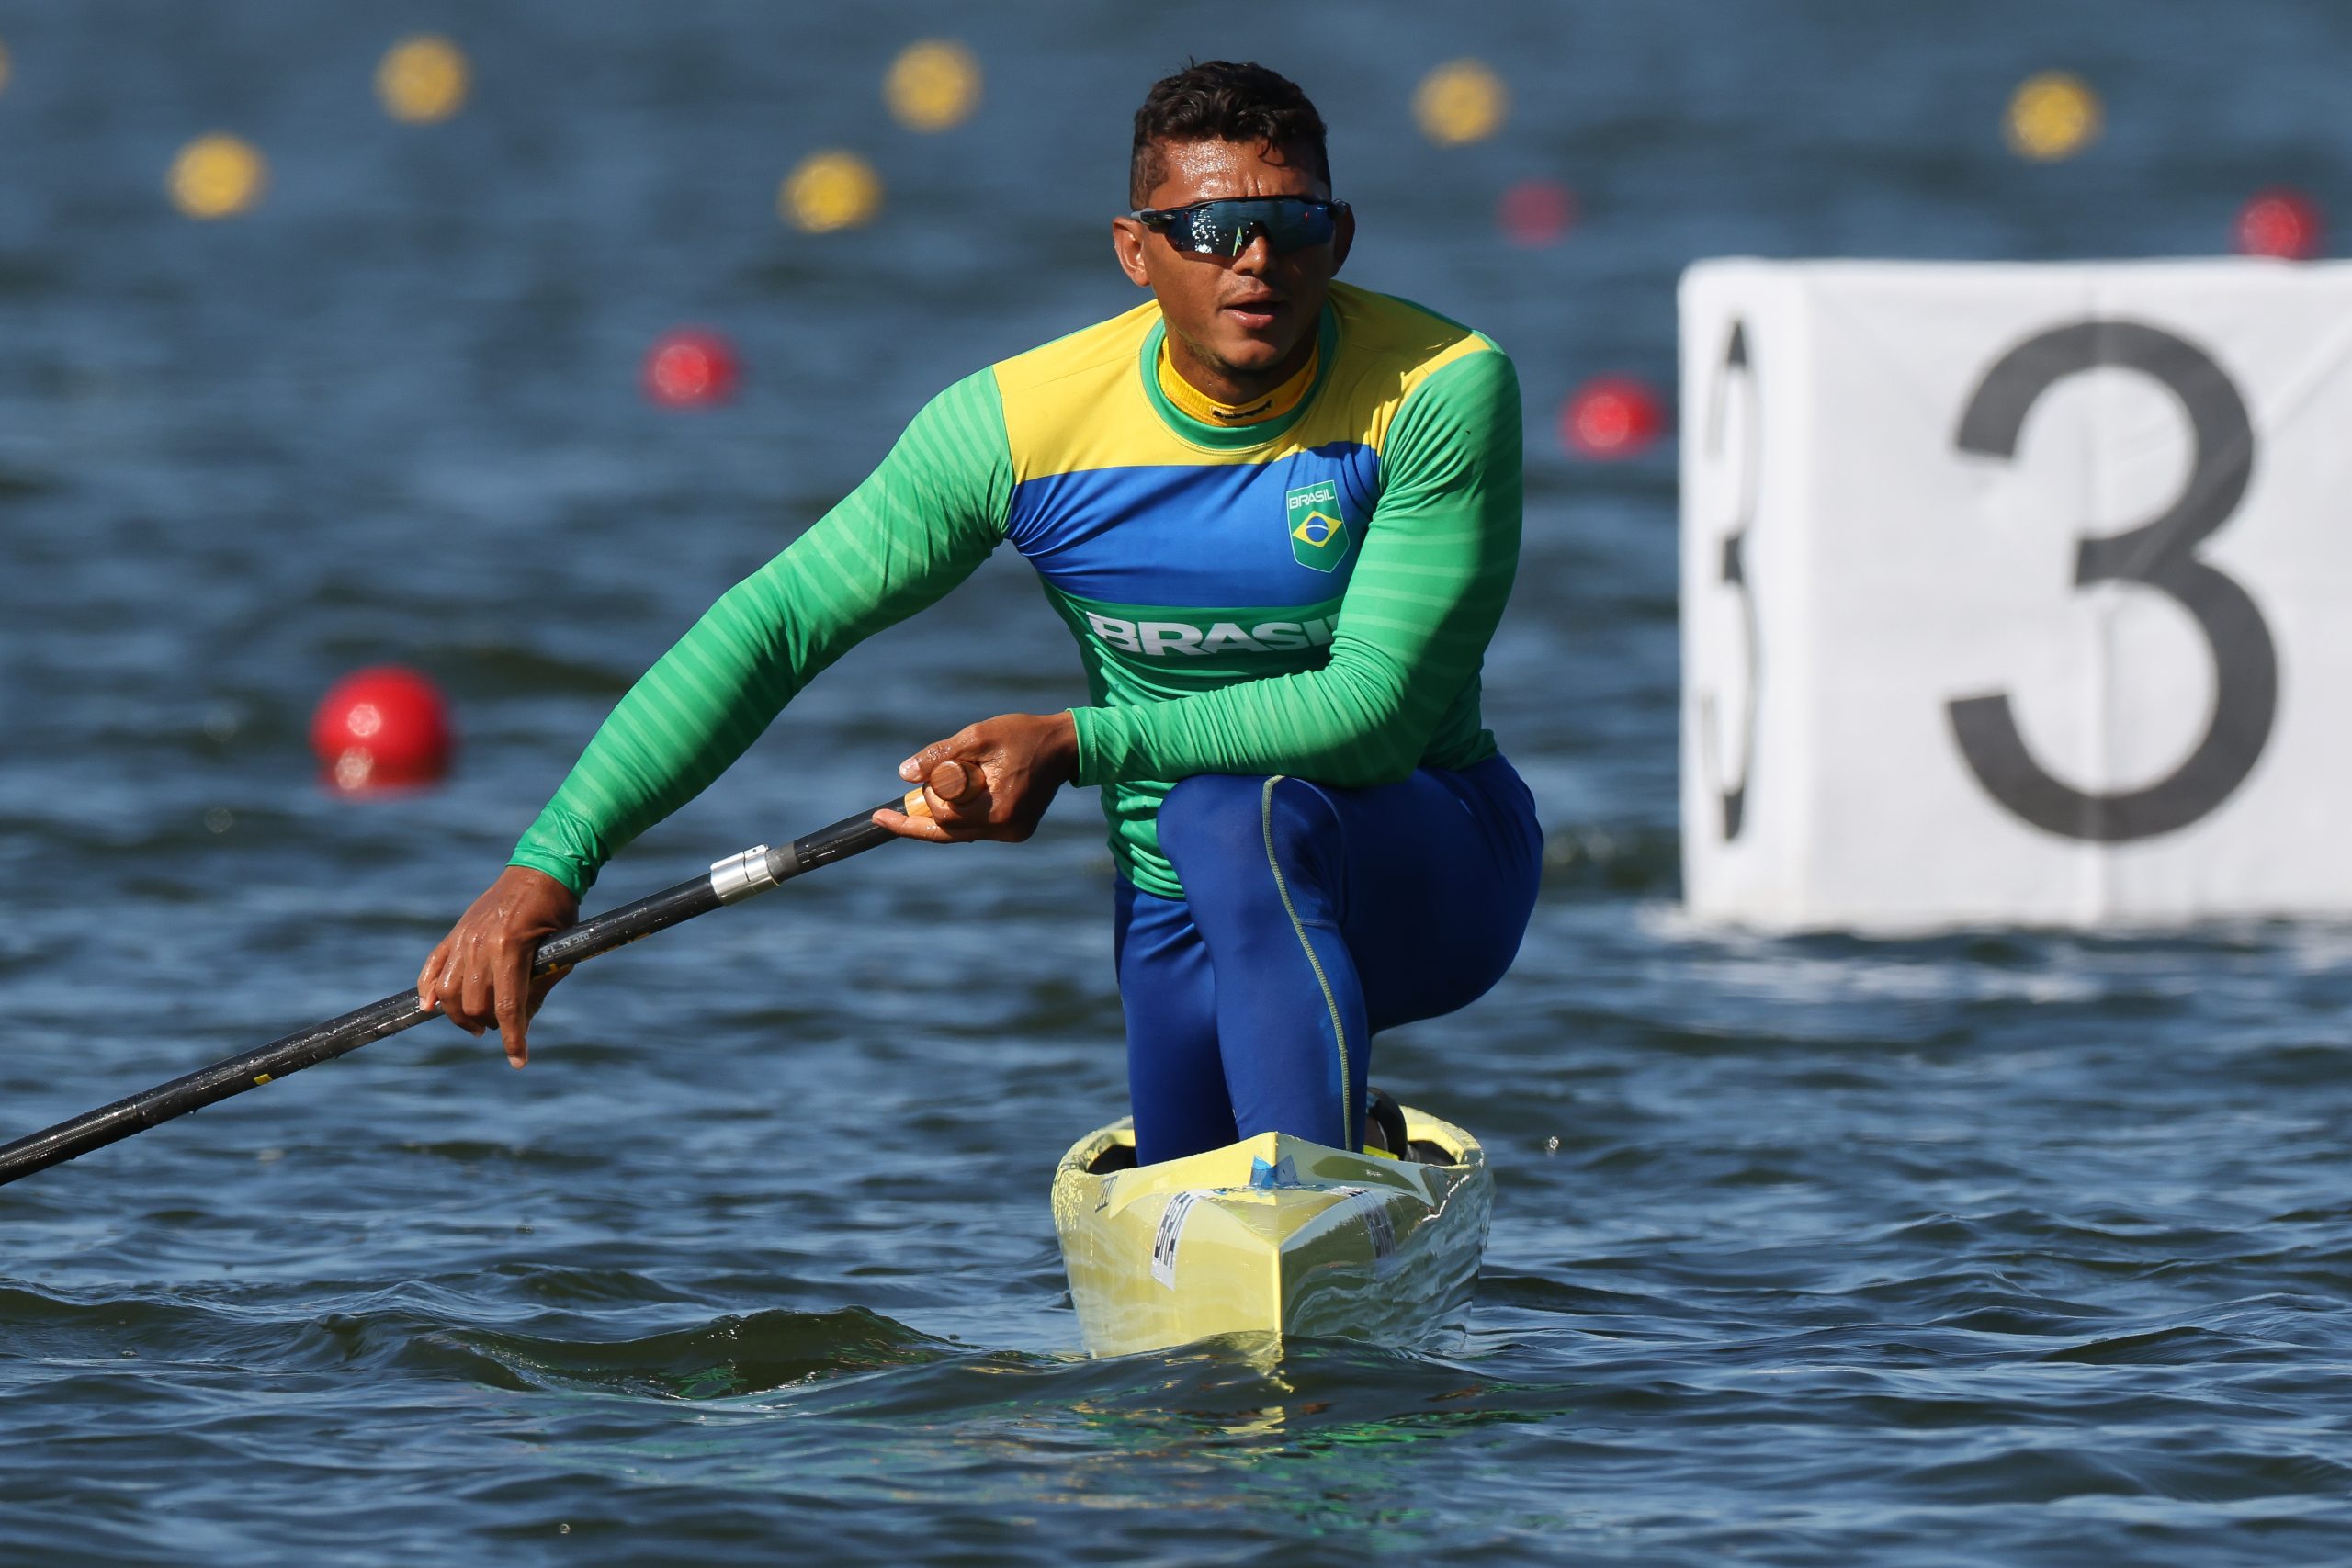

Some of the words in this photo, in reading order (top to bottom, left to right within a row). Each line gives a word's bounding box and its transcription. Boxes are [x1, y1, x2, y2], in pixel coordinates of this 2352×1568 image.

[1289, 488, 1335, 510] BRASIL
[1702, 320, 1761, 840] 3
[1947, 320, 2278, 843] 3
